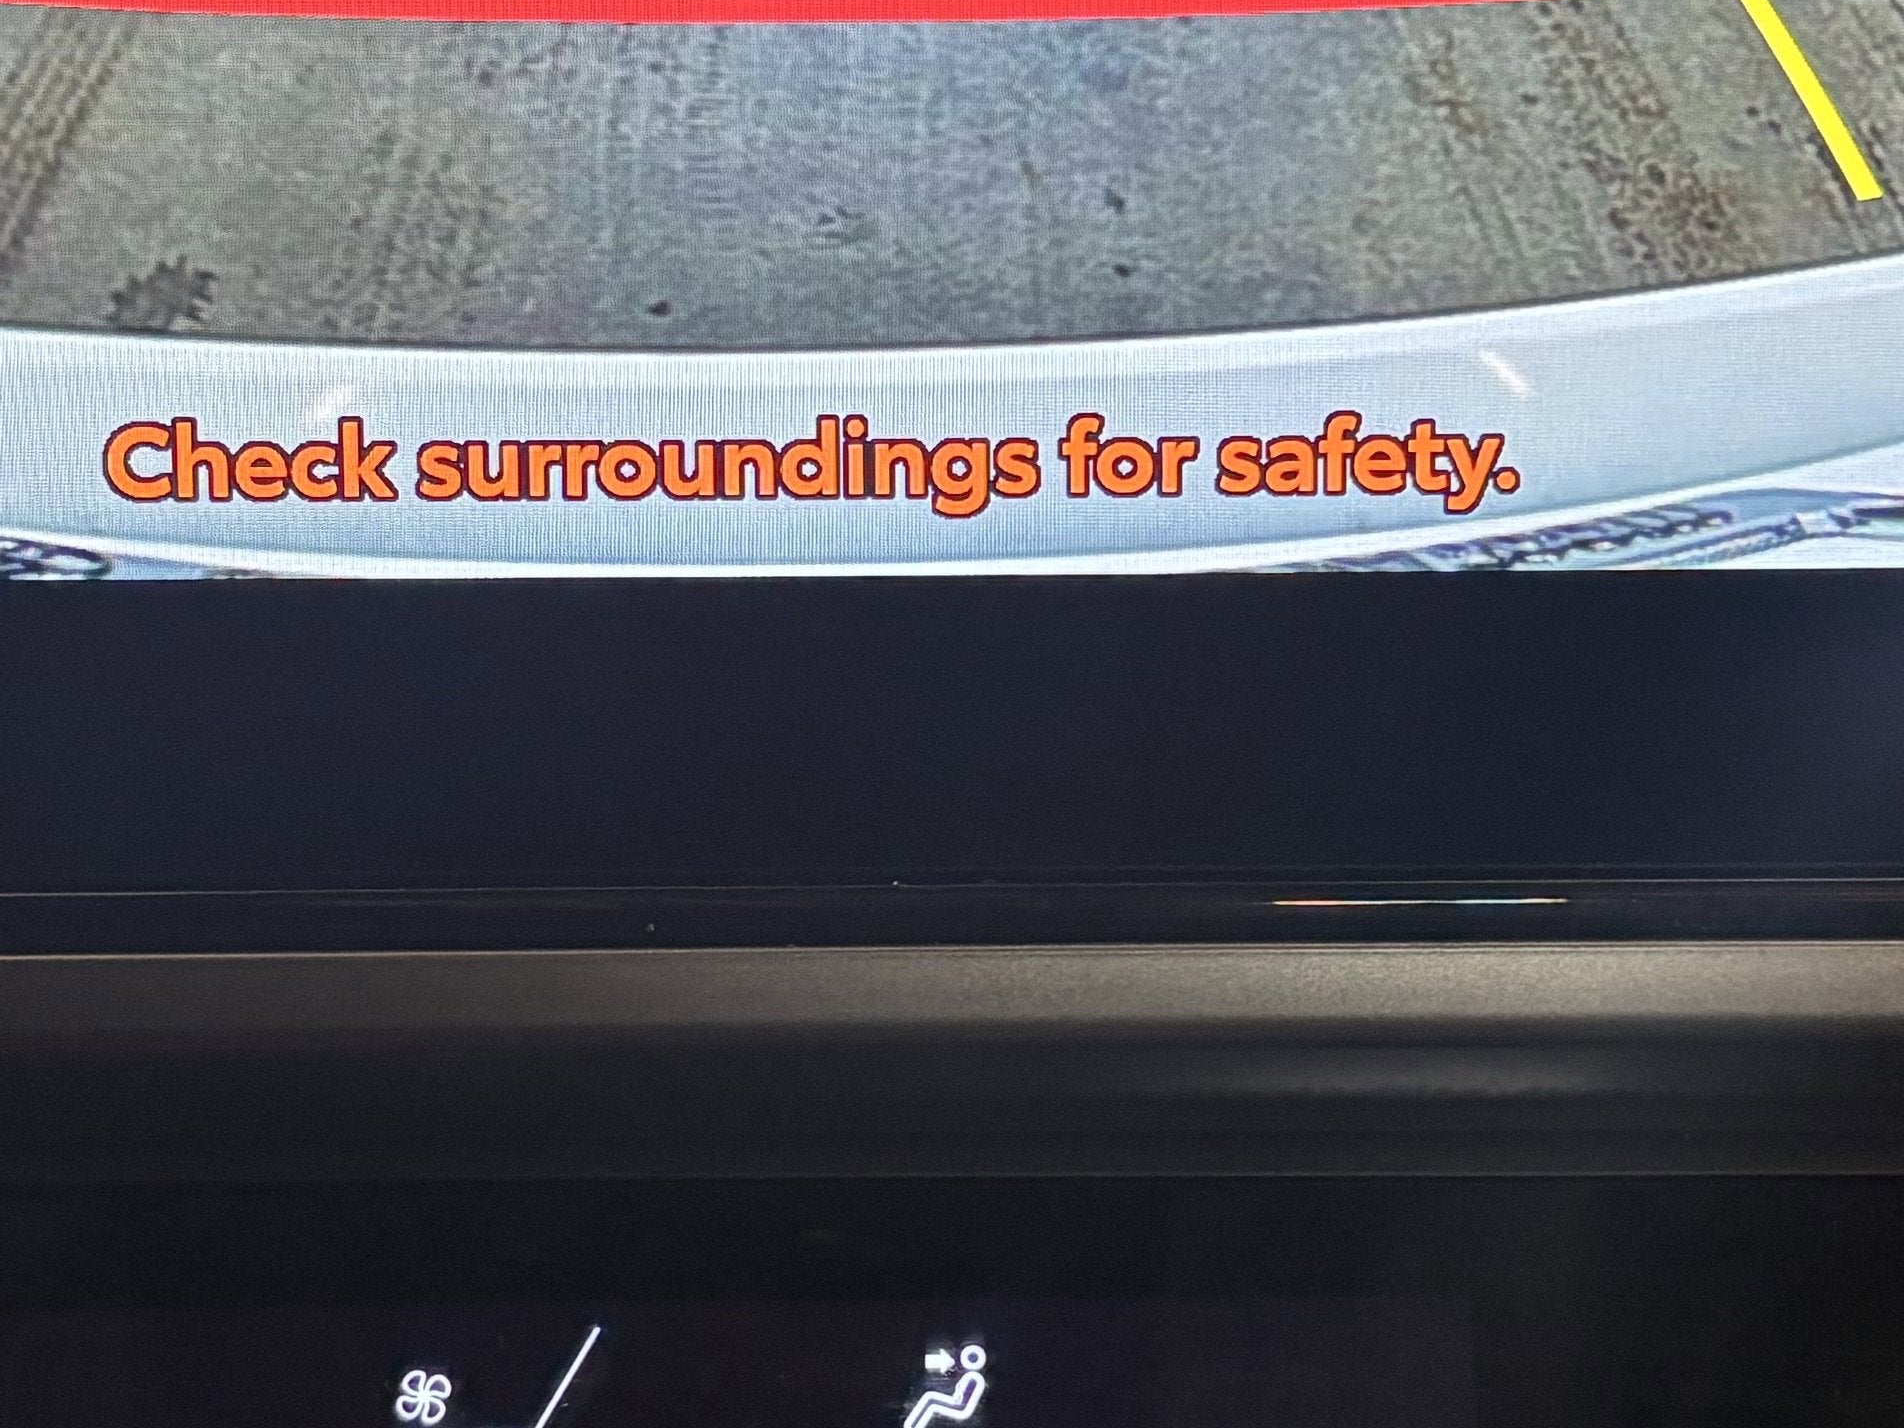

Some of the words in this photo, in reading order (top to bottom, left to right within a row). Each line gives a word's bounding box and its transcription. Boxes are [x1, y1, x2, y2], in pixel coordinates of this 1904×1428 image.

[102, 417, 399, 504] Check
[413, 414, 1041, 520] surroundings
[1058, 412, 1198, 499] for
[1214, 411, 1522, 513] safety.
